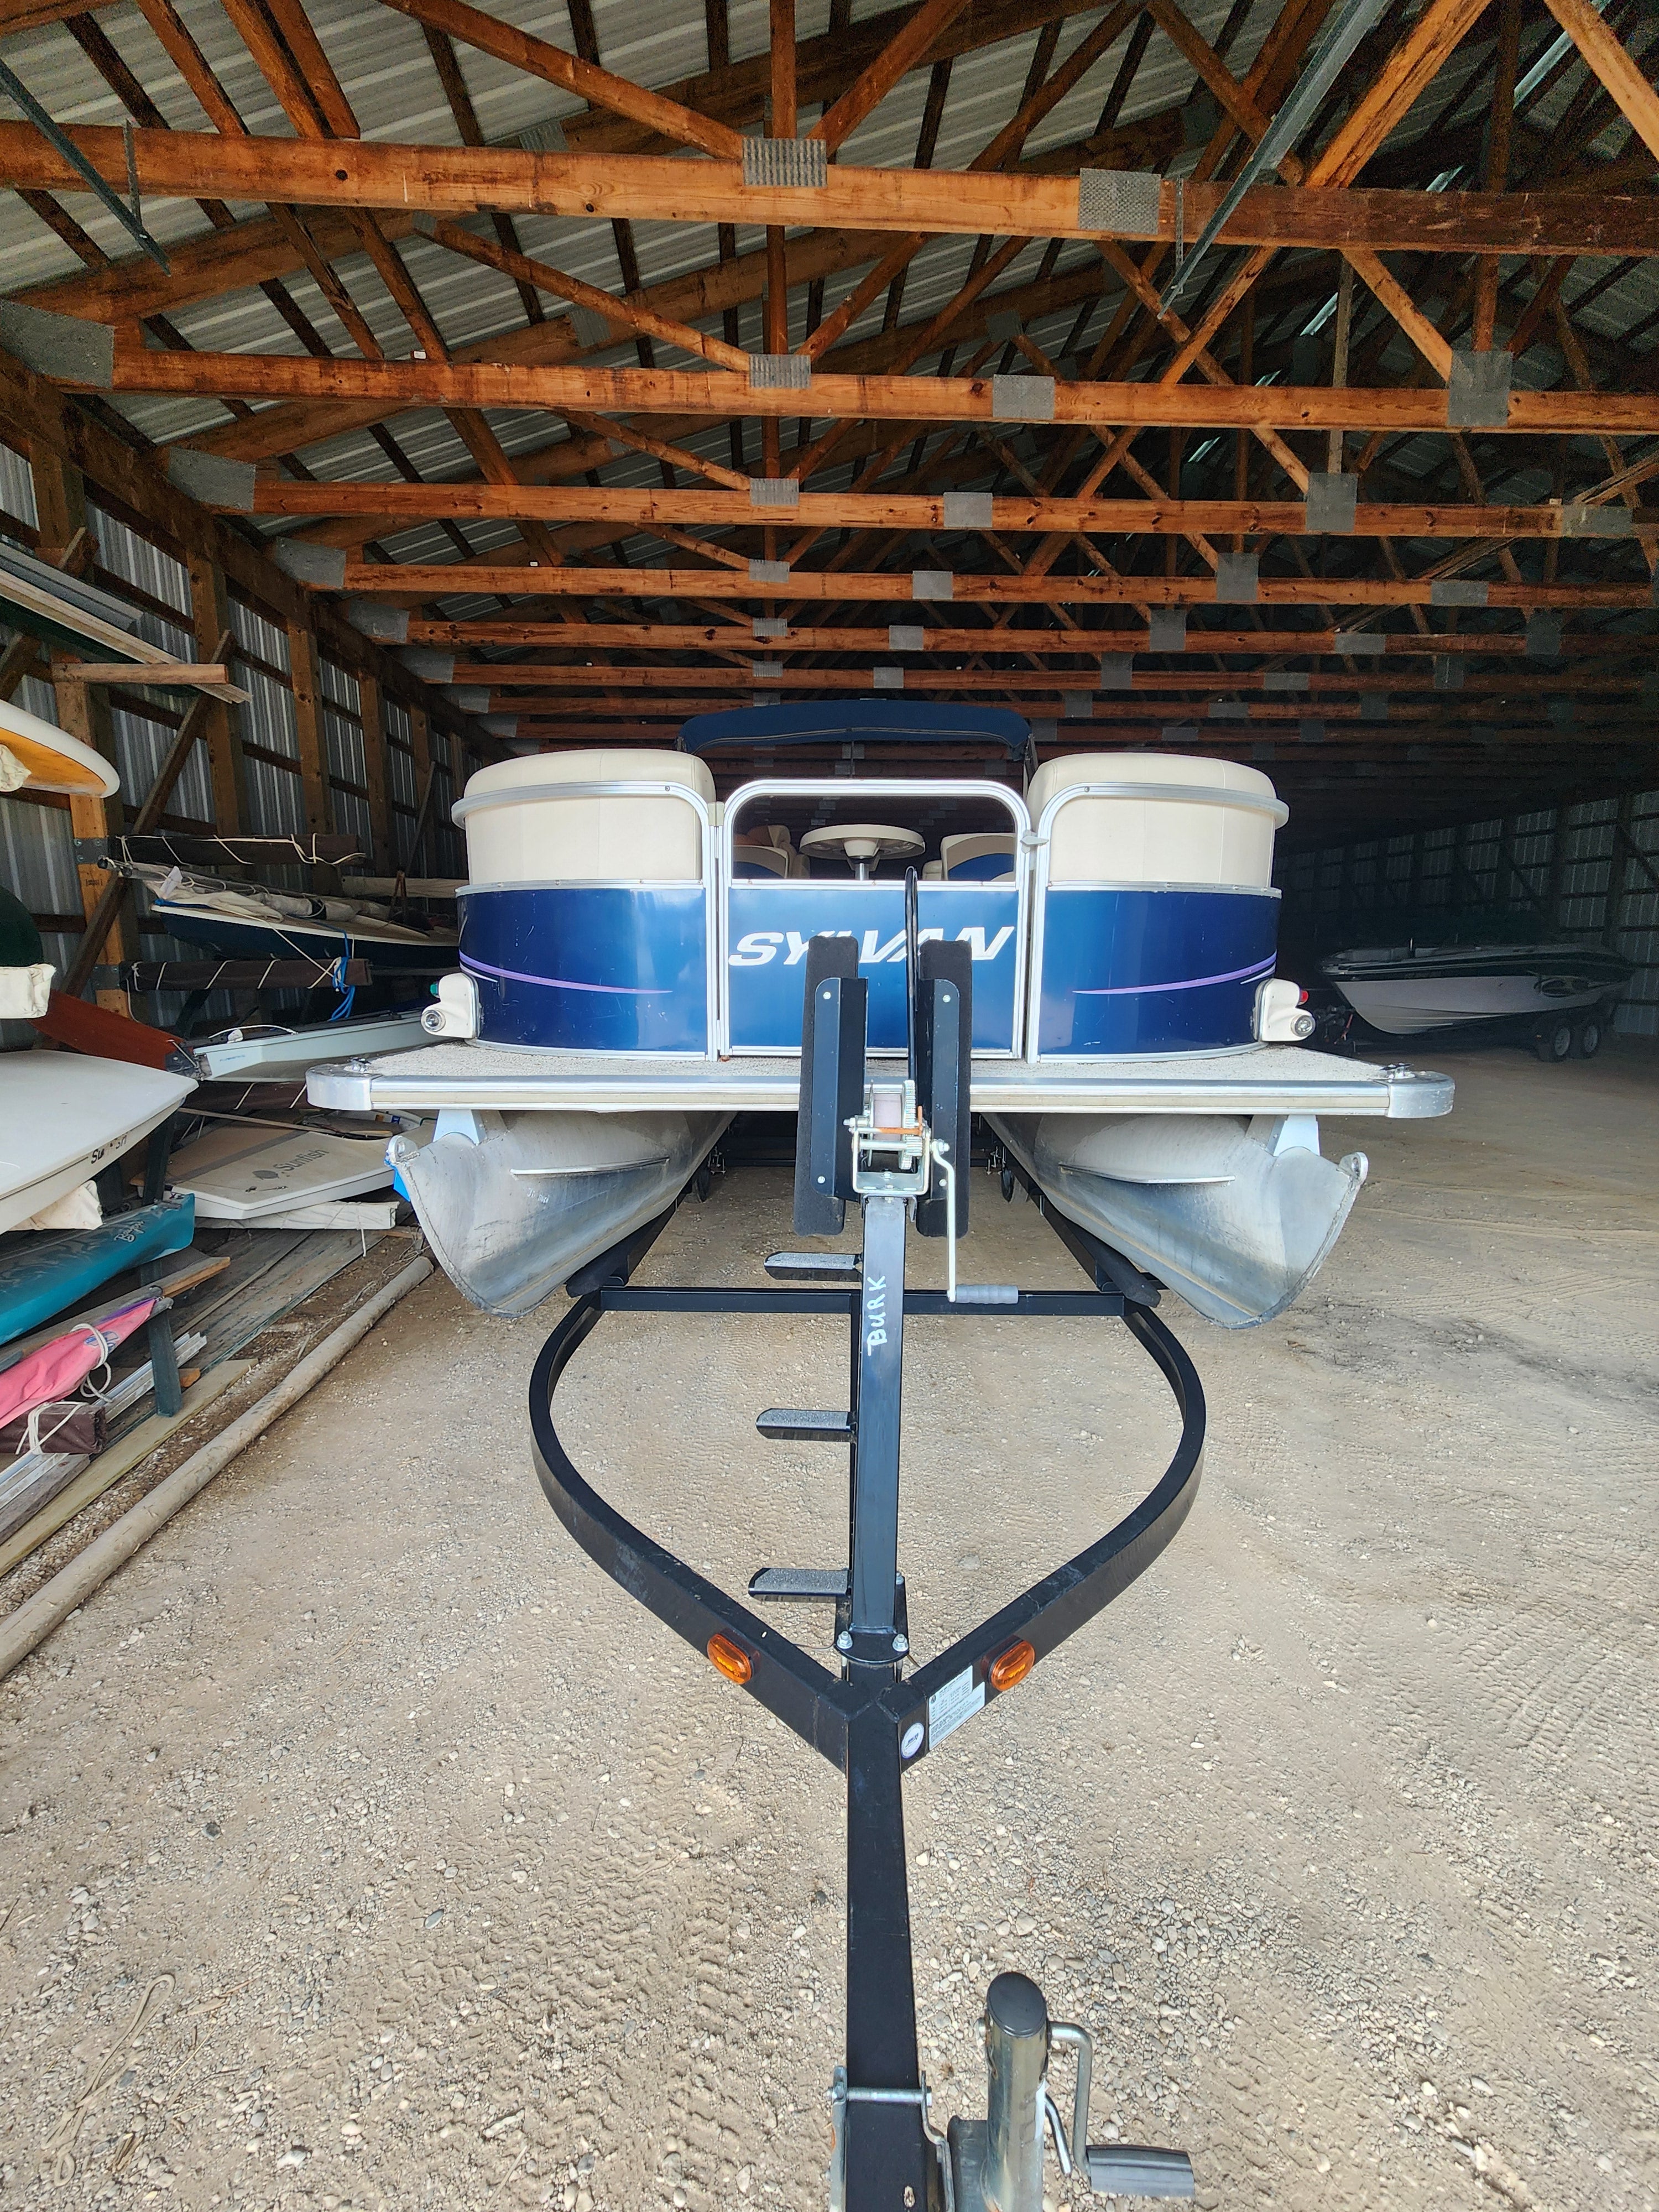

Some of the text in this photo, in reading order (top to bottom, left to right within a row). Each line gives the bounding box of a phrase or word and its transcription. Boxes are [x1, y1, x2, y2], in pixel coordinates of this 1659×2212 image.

[728, 926, 1015, 966] SYVAN
[273, 1150, 330, 1171] Sunfish
[867, 1275, 888, 1356] BURK
